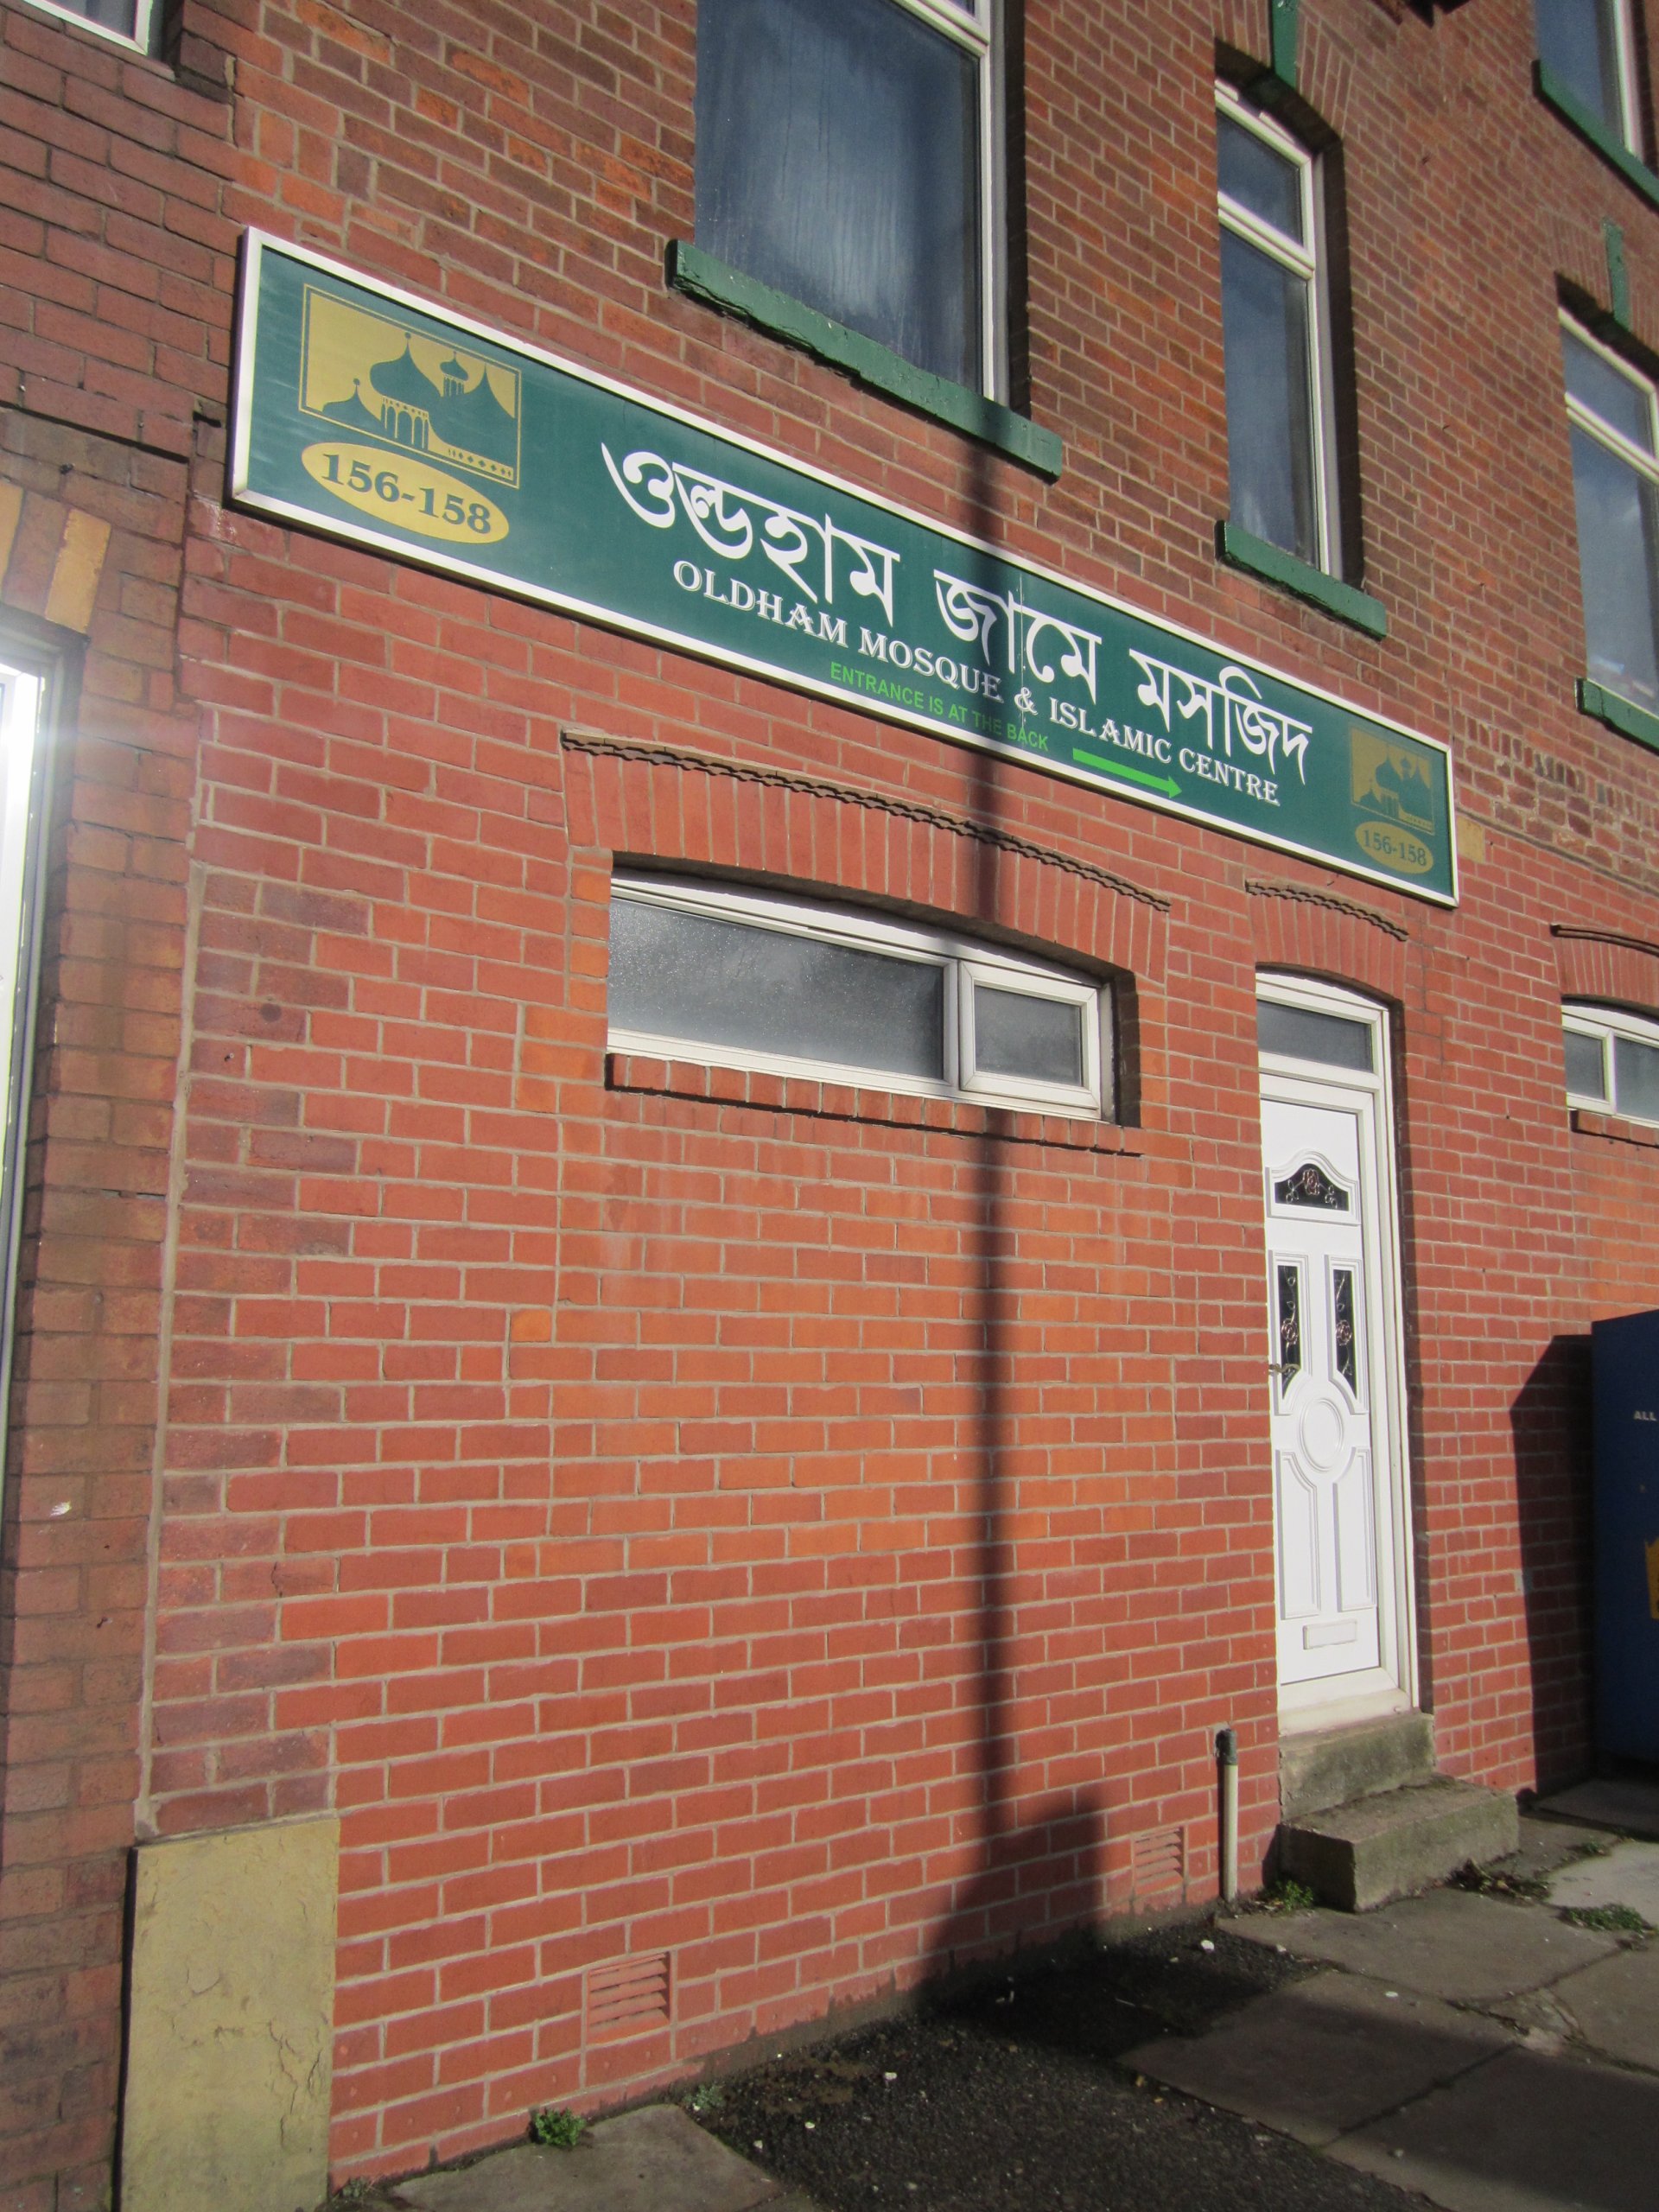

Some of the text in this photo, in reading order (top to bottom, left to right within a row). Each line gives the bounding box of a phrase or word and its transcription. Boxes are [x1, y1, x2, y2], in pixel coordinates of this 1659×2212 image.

[321, 453, 493, 536] 156-158
[673, 560, 1281, 807] OLDHAM MOSQUE & ISLAMIC CENTRE
[830, 661, 1049, 751] ENTRANCE IS AT THE BACK
[934, 569, 1102, 703] জামে
[1129, 648, 1313, 785] মসজিদ
[1363, 830, 1427, 867] 156-158
[1633, 1410, 1656, 1421] ALL
